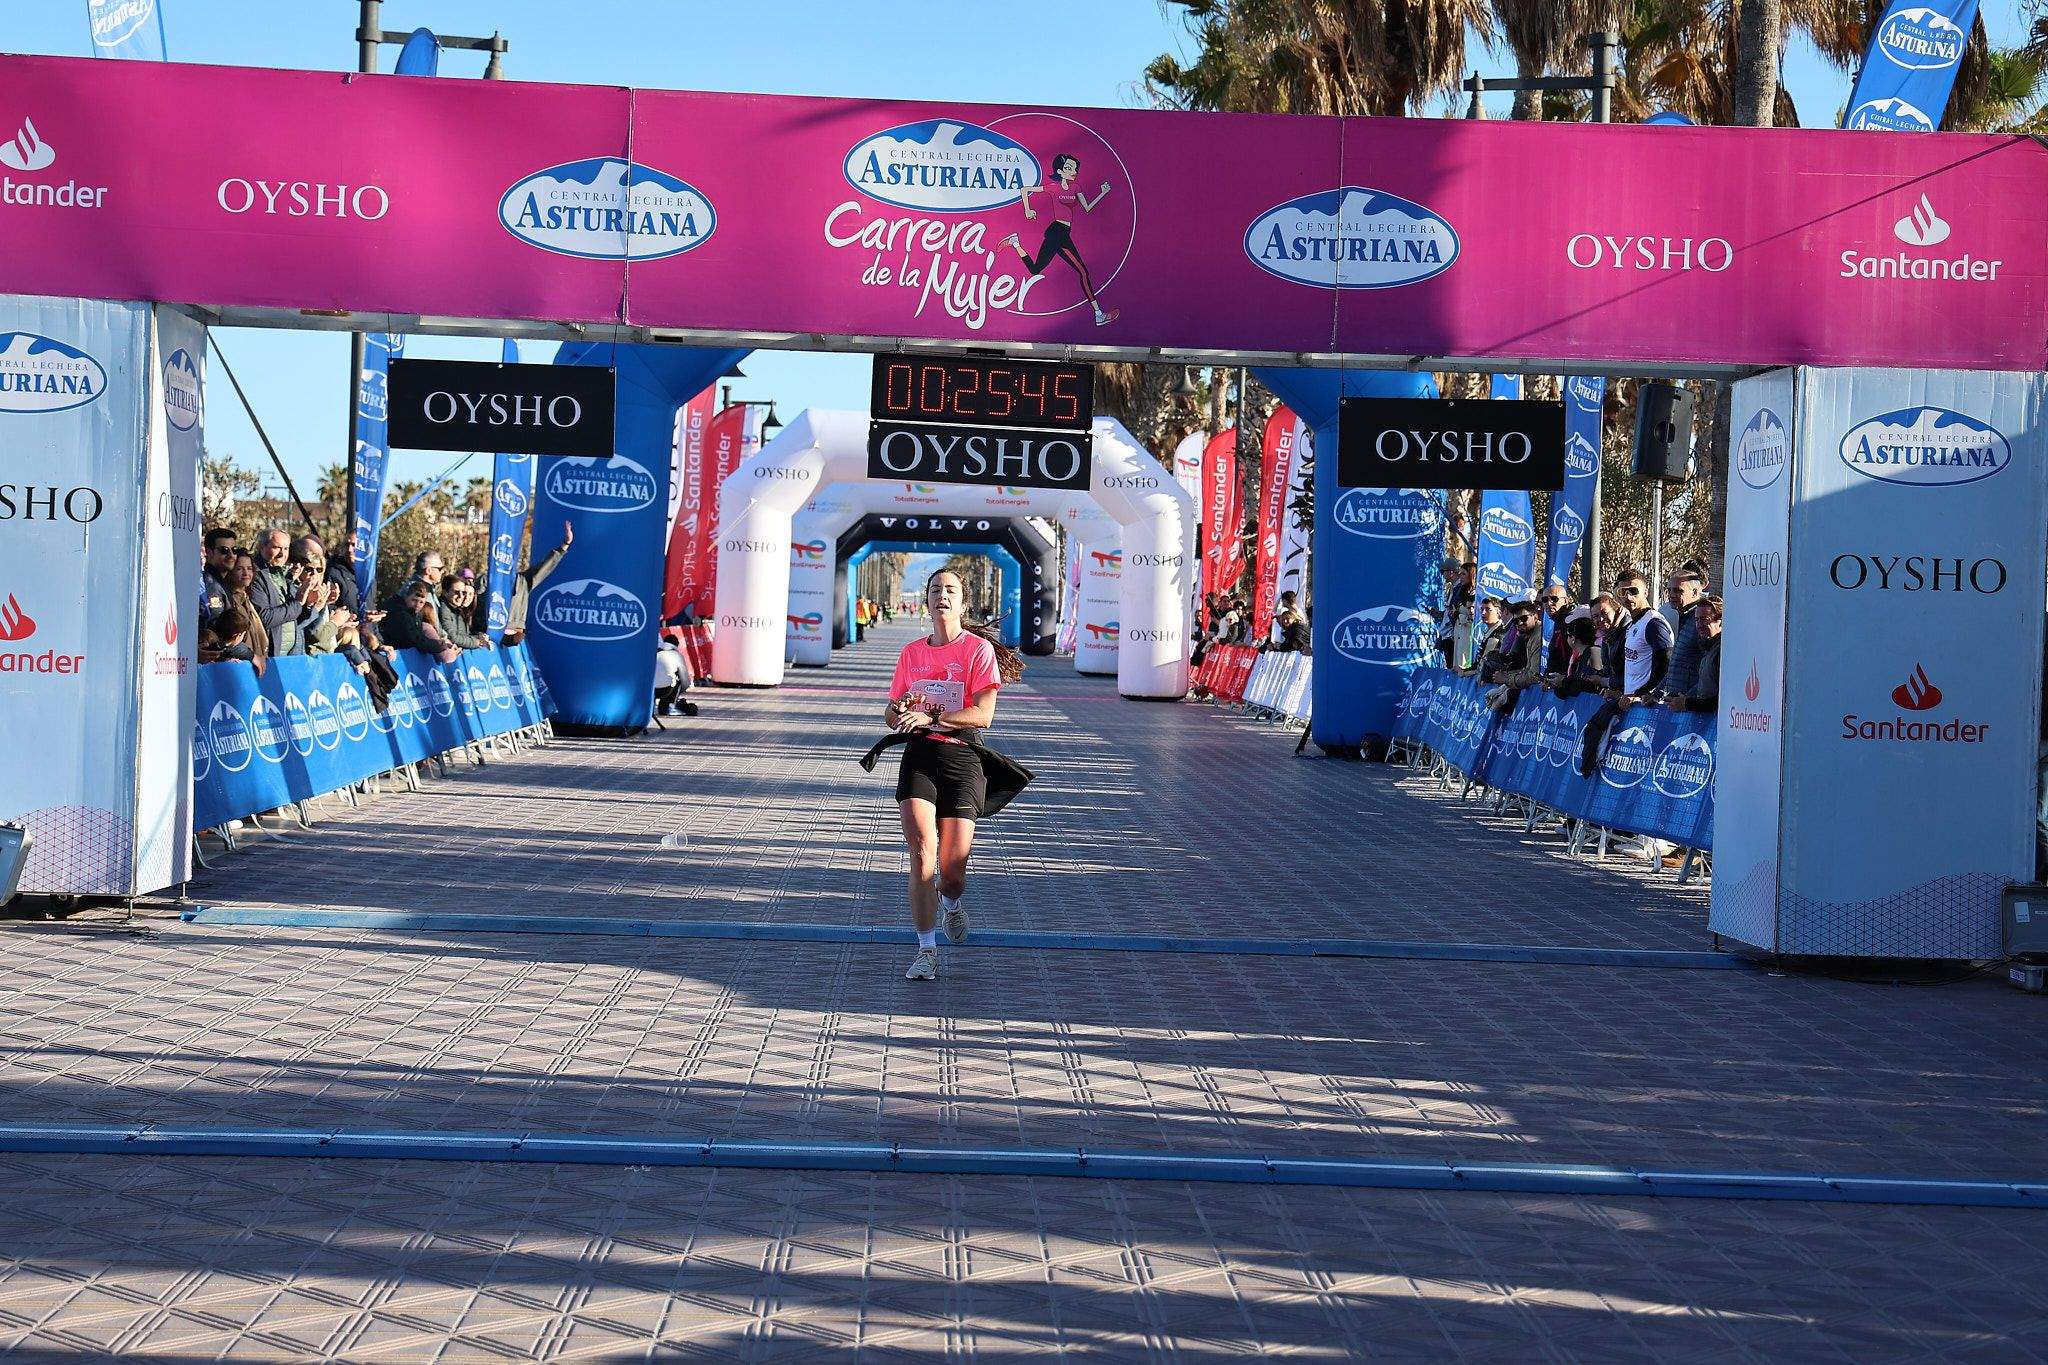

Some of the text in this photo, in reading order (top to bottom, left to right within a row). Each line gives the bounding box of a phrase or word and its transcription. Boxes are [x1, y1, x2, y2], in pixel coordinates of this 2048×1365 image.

[859, 149, 1027, 191] ASTURIANA
[889, 149, 1022, 163] CENTRAL LECHERA
[0, 176, 108, 209] tander
[216, 177, 390, 221] OYSHO
[550, 190, 693, 207] CENTRAL LECHERA
[514, 191, 700, 238] ASTURIANA
[822, 200, 987, 255] Carrera
[1295, 221, 1437, 235] CENTRAL LECHERA
[1260, 222, 1443, 264] ASTURIANA
[1566, 234, 1734, 272] OYSHO
[1840, 250, 2002, 281] Santander
[861, 249, 1046, 330] de la Mujer
[32, 361, 90, 372] LECHERA
[886, 364, 1079, 420] 00:25:45
[423, 391, 582, 427] OYSHO
[1375, 429, 1532, 464] OYSHO
[1851, 434, 1998, 467] ASTURIANA
[1878, 433, 1993, 445] CENTRAL LECHERA
[685, 408, 703, 511] Santander
[880, 431, 1081, 482] OYSHO
[1740, 441, 1784, 471] ASTURIANA
[550, 471, 650, 500] ASTURIANA
[754, 466, 810, 481] OYSHO
[1103, 476, 1159, 489] OYSHO
[1266, 427, 1294, 530] Santander
[158, 491, 196, 532] OYSHO
[1212, 455, 1227, 542] Santander
[880, 516, 990, 531] VOLVO
[725, 540, 777, 553] OYSHO
[1132, 553, 1184, 567] OYSHO
[1731, 551, 1782, 588] OYSHO
[1829, 554, 2008, 594] OYSHO
[540, 599, 640, 628] ASTURIANA
[1033, 564, 1042, 645] VOLVO
[721, 615, 772, 629] OYSHO
[1130, 629, 1181, 642] OYSHO
[1729, 706, 1772, 733] Santander
[1841, 714, 1991, 743] Santander
